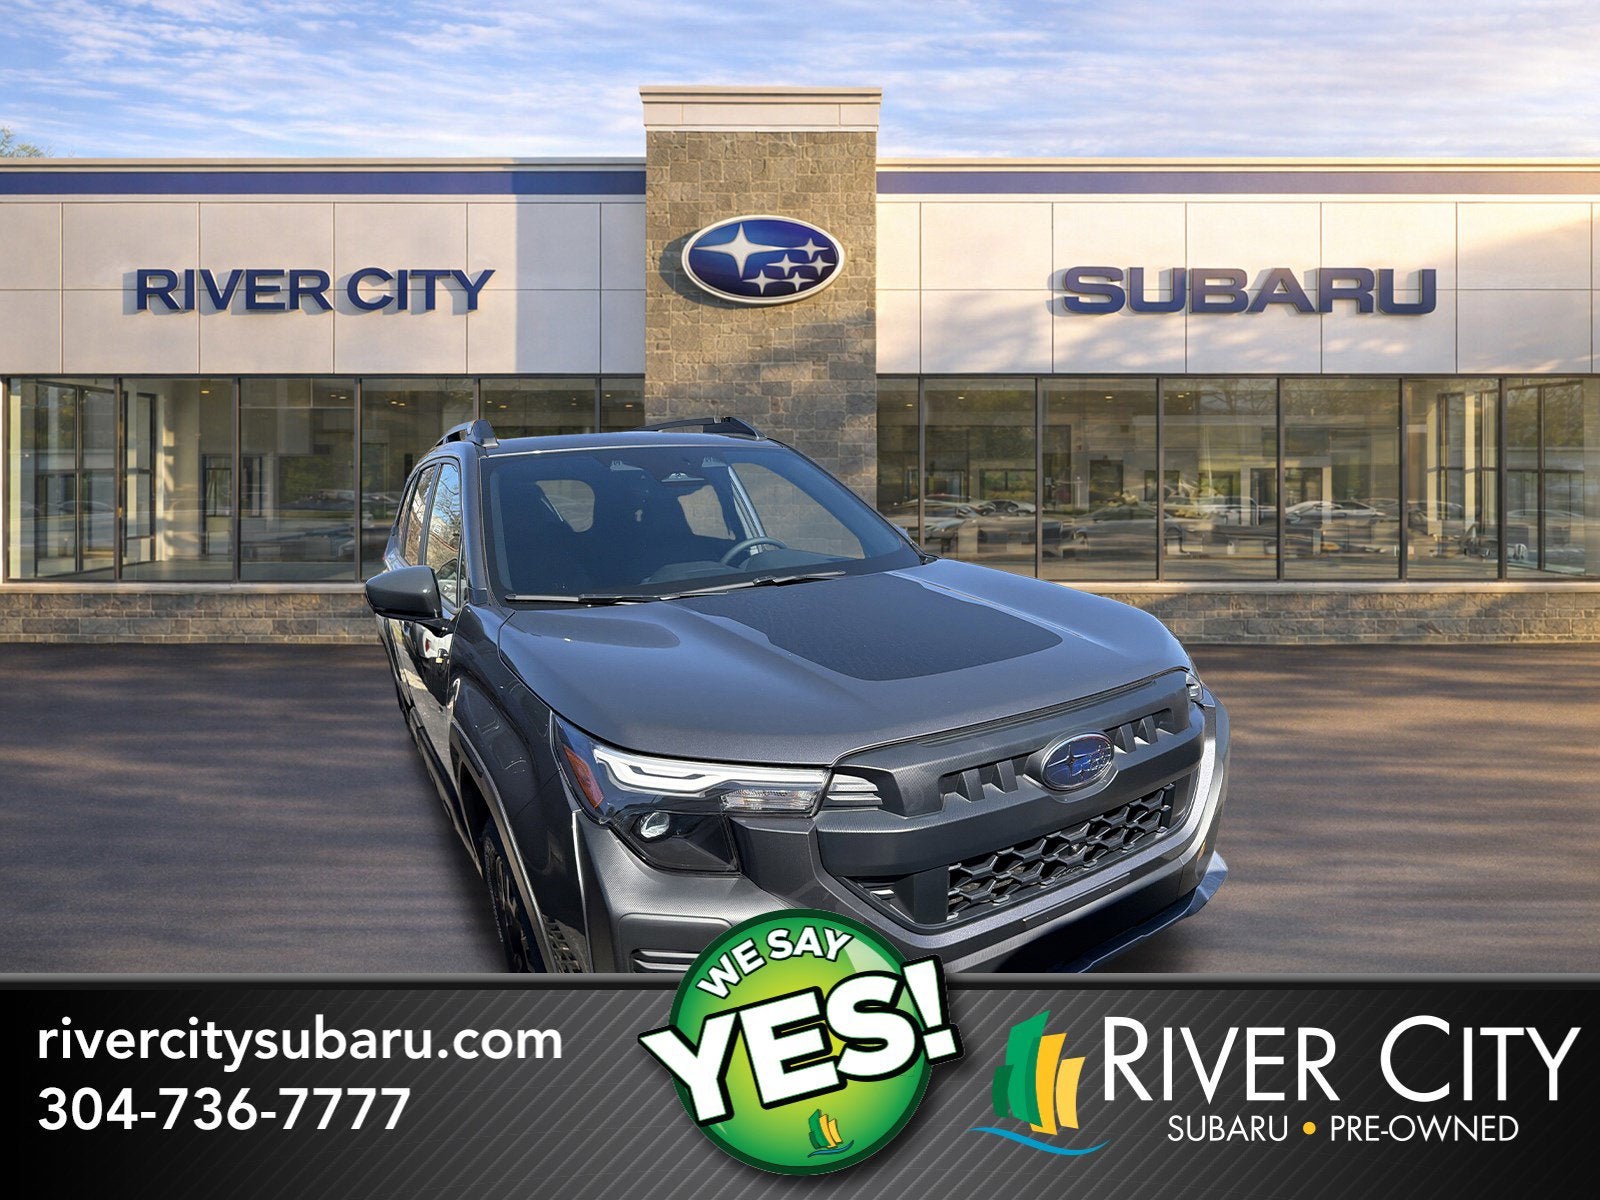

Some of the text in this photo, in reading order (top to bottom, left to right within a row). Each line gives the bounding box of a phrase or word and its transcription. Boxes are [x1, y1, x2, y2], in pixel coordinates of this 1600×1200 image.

[136, 268, 496, 312] RIVER CITY
[1062, 266, 1438, 315] SUBARU
